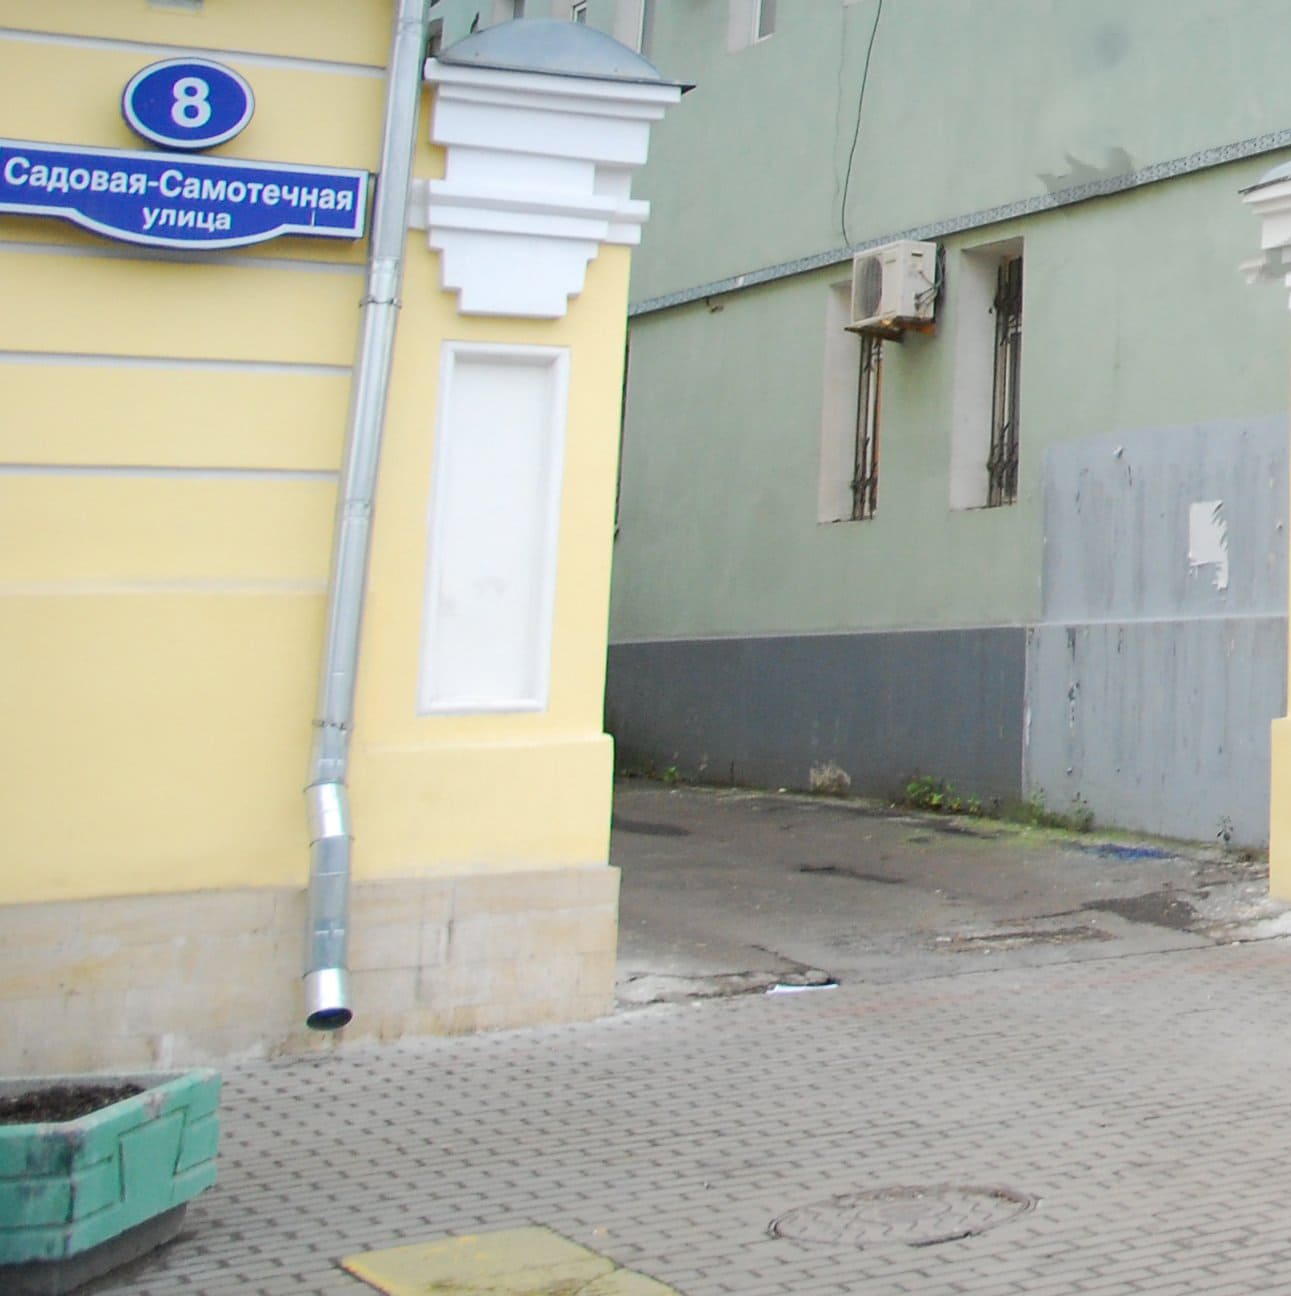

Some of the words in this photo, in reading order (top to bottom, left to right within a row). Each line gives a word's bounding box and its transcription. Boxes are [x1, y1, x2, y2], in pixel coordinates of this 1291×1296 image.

[170, 76, 212, 129] 8
[4, 156, 354, 212] Садовая-Самотечная
[142, 206, 232, 232] улица
